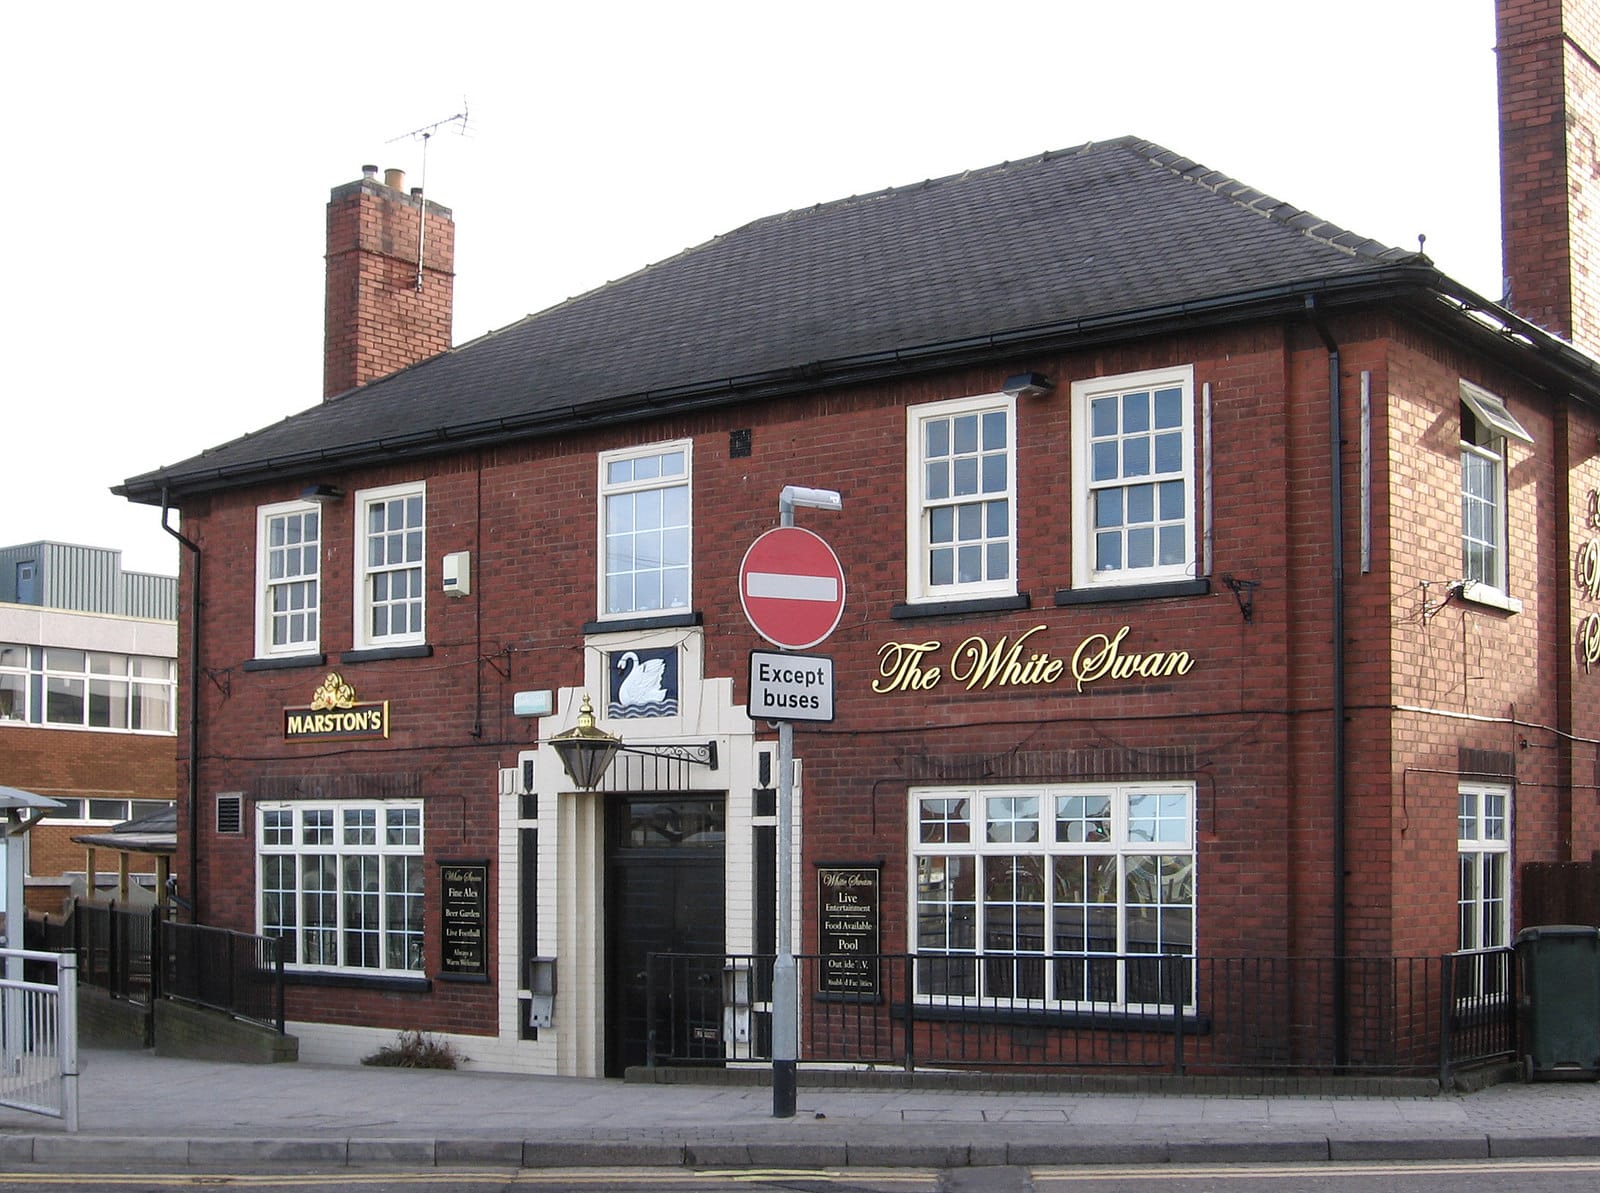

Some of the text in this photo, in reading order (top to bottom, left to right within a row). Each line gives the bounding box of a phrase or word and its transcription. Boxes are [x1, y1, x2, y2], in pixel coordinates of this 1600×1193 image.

[872, 625, 1195, 693] The White Swan
[760, 663, 824, 688] Except
[764, 688, 819, 709] buses
[287, 710, 381, 734] MARSTON'S
[823, 872, 873, 888] White Swan
[448, 888, 478, 898] Fine Ales
[839, 892, 858, 903] Live
[825, 903, 871, 912] Entertainment
[445, 909, 480, 918] Beer Garden
[825, 921, 873, 930] Food Available
[446, 928, 480, 938] Live Football
[838, 939, 859, 950] Pool
[828, 959, 855, 969] Outide
